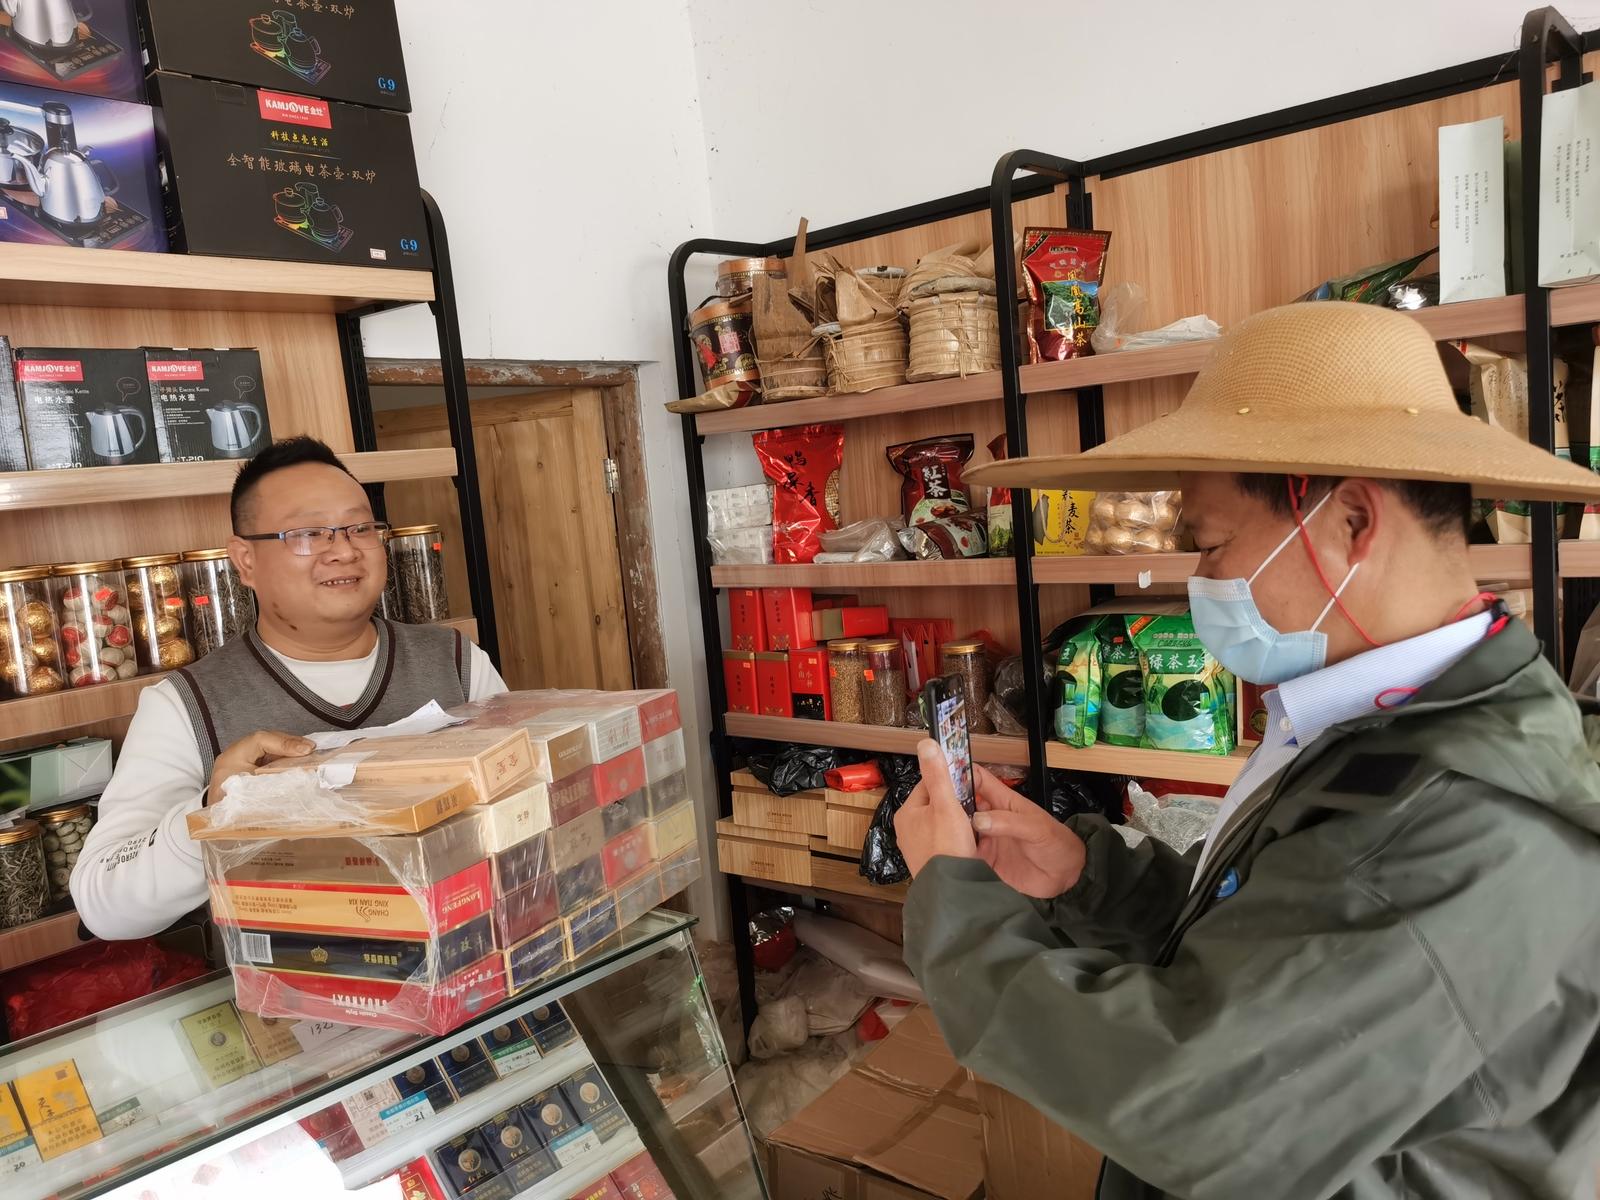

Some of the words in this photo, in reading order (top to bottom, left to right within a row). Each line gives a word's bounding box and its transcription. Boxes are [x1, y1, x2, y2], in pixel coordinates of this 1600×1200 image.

[377, 77, 395, 91] G9
[265, 99, 309, 114] KAMJOVE
[271, 130, 329, 147] 科技点亮生活
[400, 238, 418, 251] G9
[160, 393, 196, 402] 电热水壶
[374, 899, 389, 907] XING
[367, 908, 389, 917] CHANG
